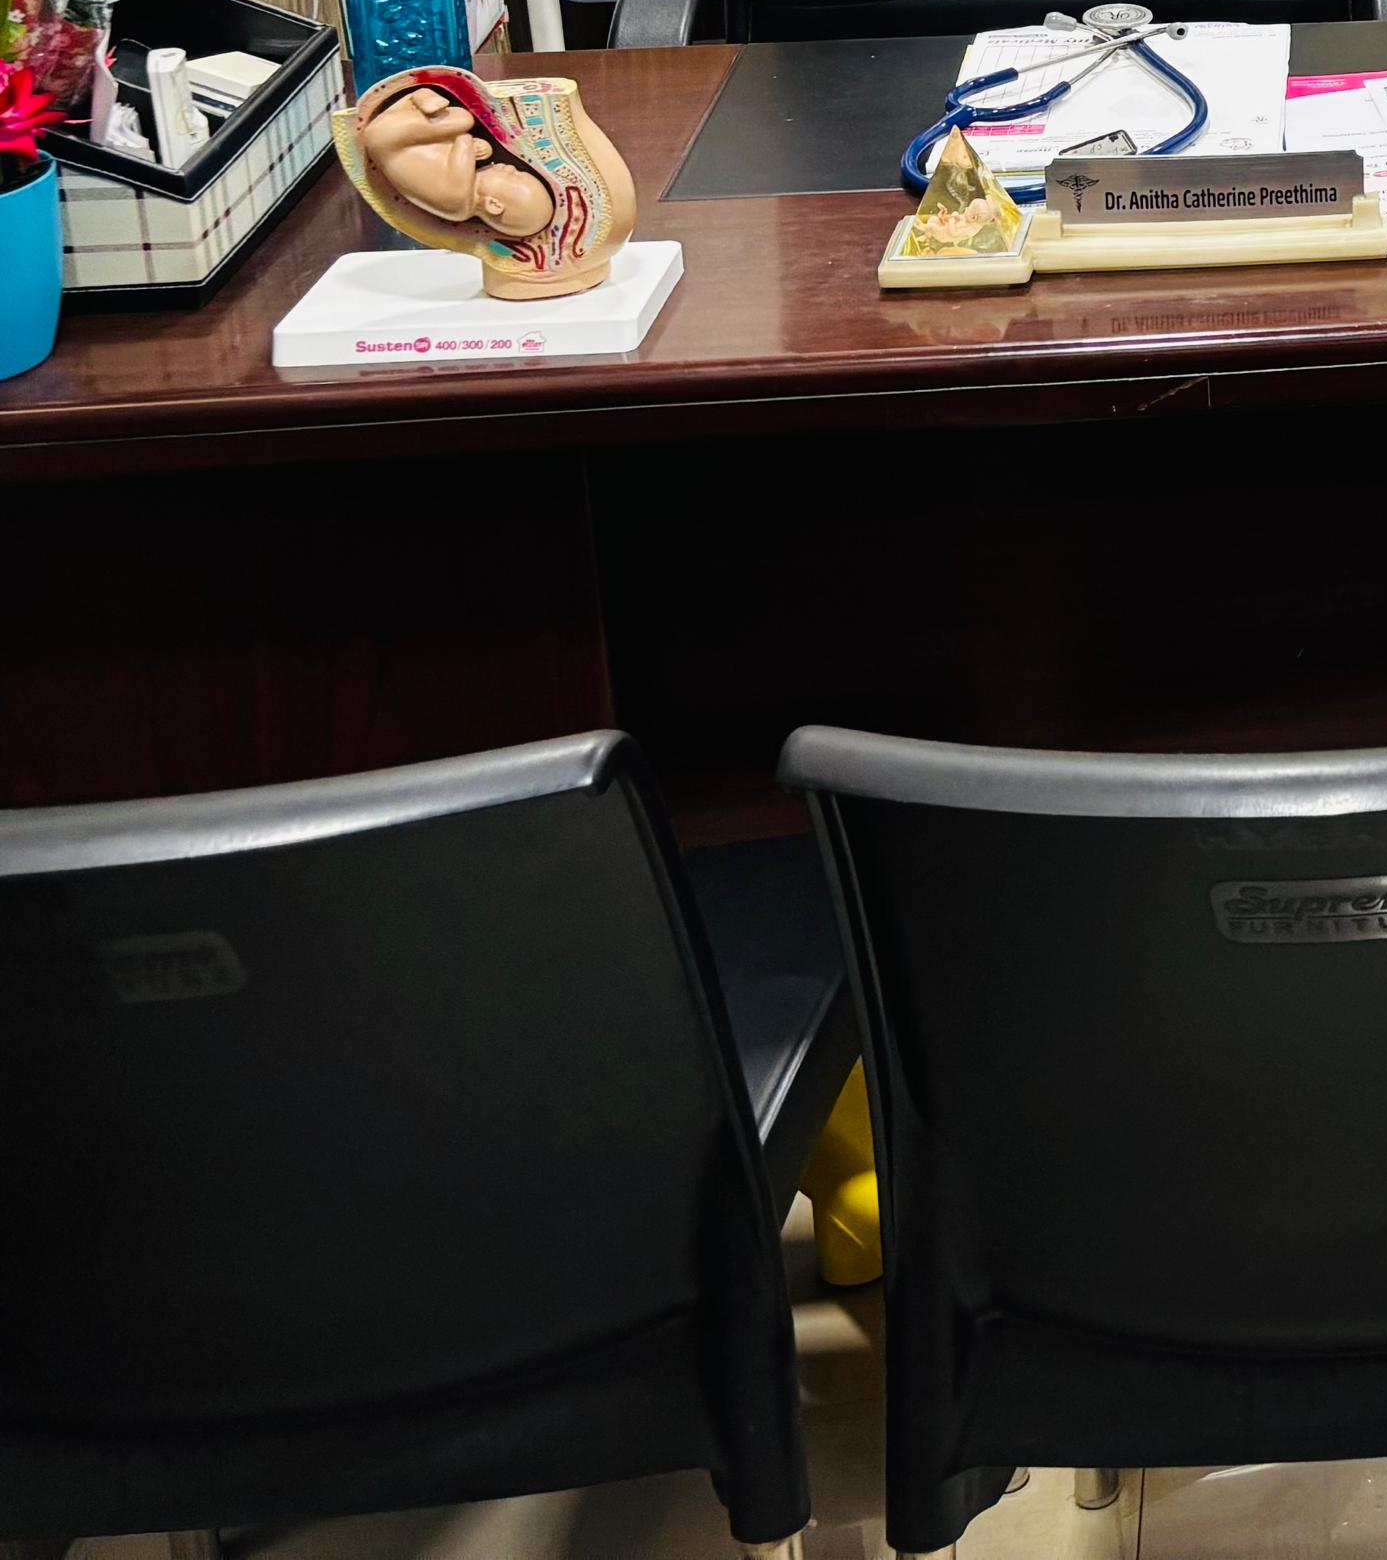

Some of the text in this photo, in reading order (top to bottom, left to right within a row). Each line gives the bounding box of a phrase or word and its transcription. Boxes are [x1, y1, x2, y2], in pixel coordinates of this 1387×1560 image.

[1105, 184, 1337, 210] Dr. Anitha Catherine Preethima
[355, 340, 412, 353] Susten
